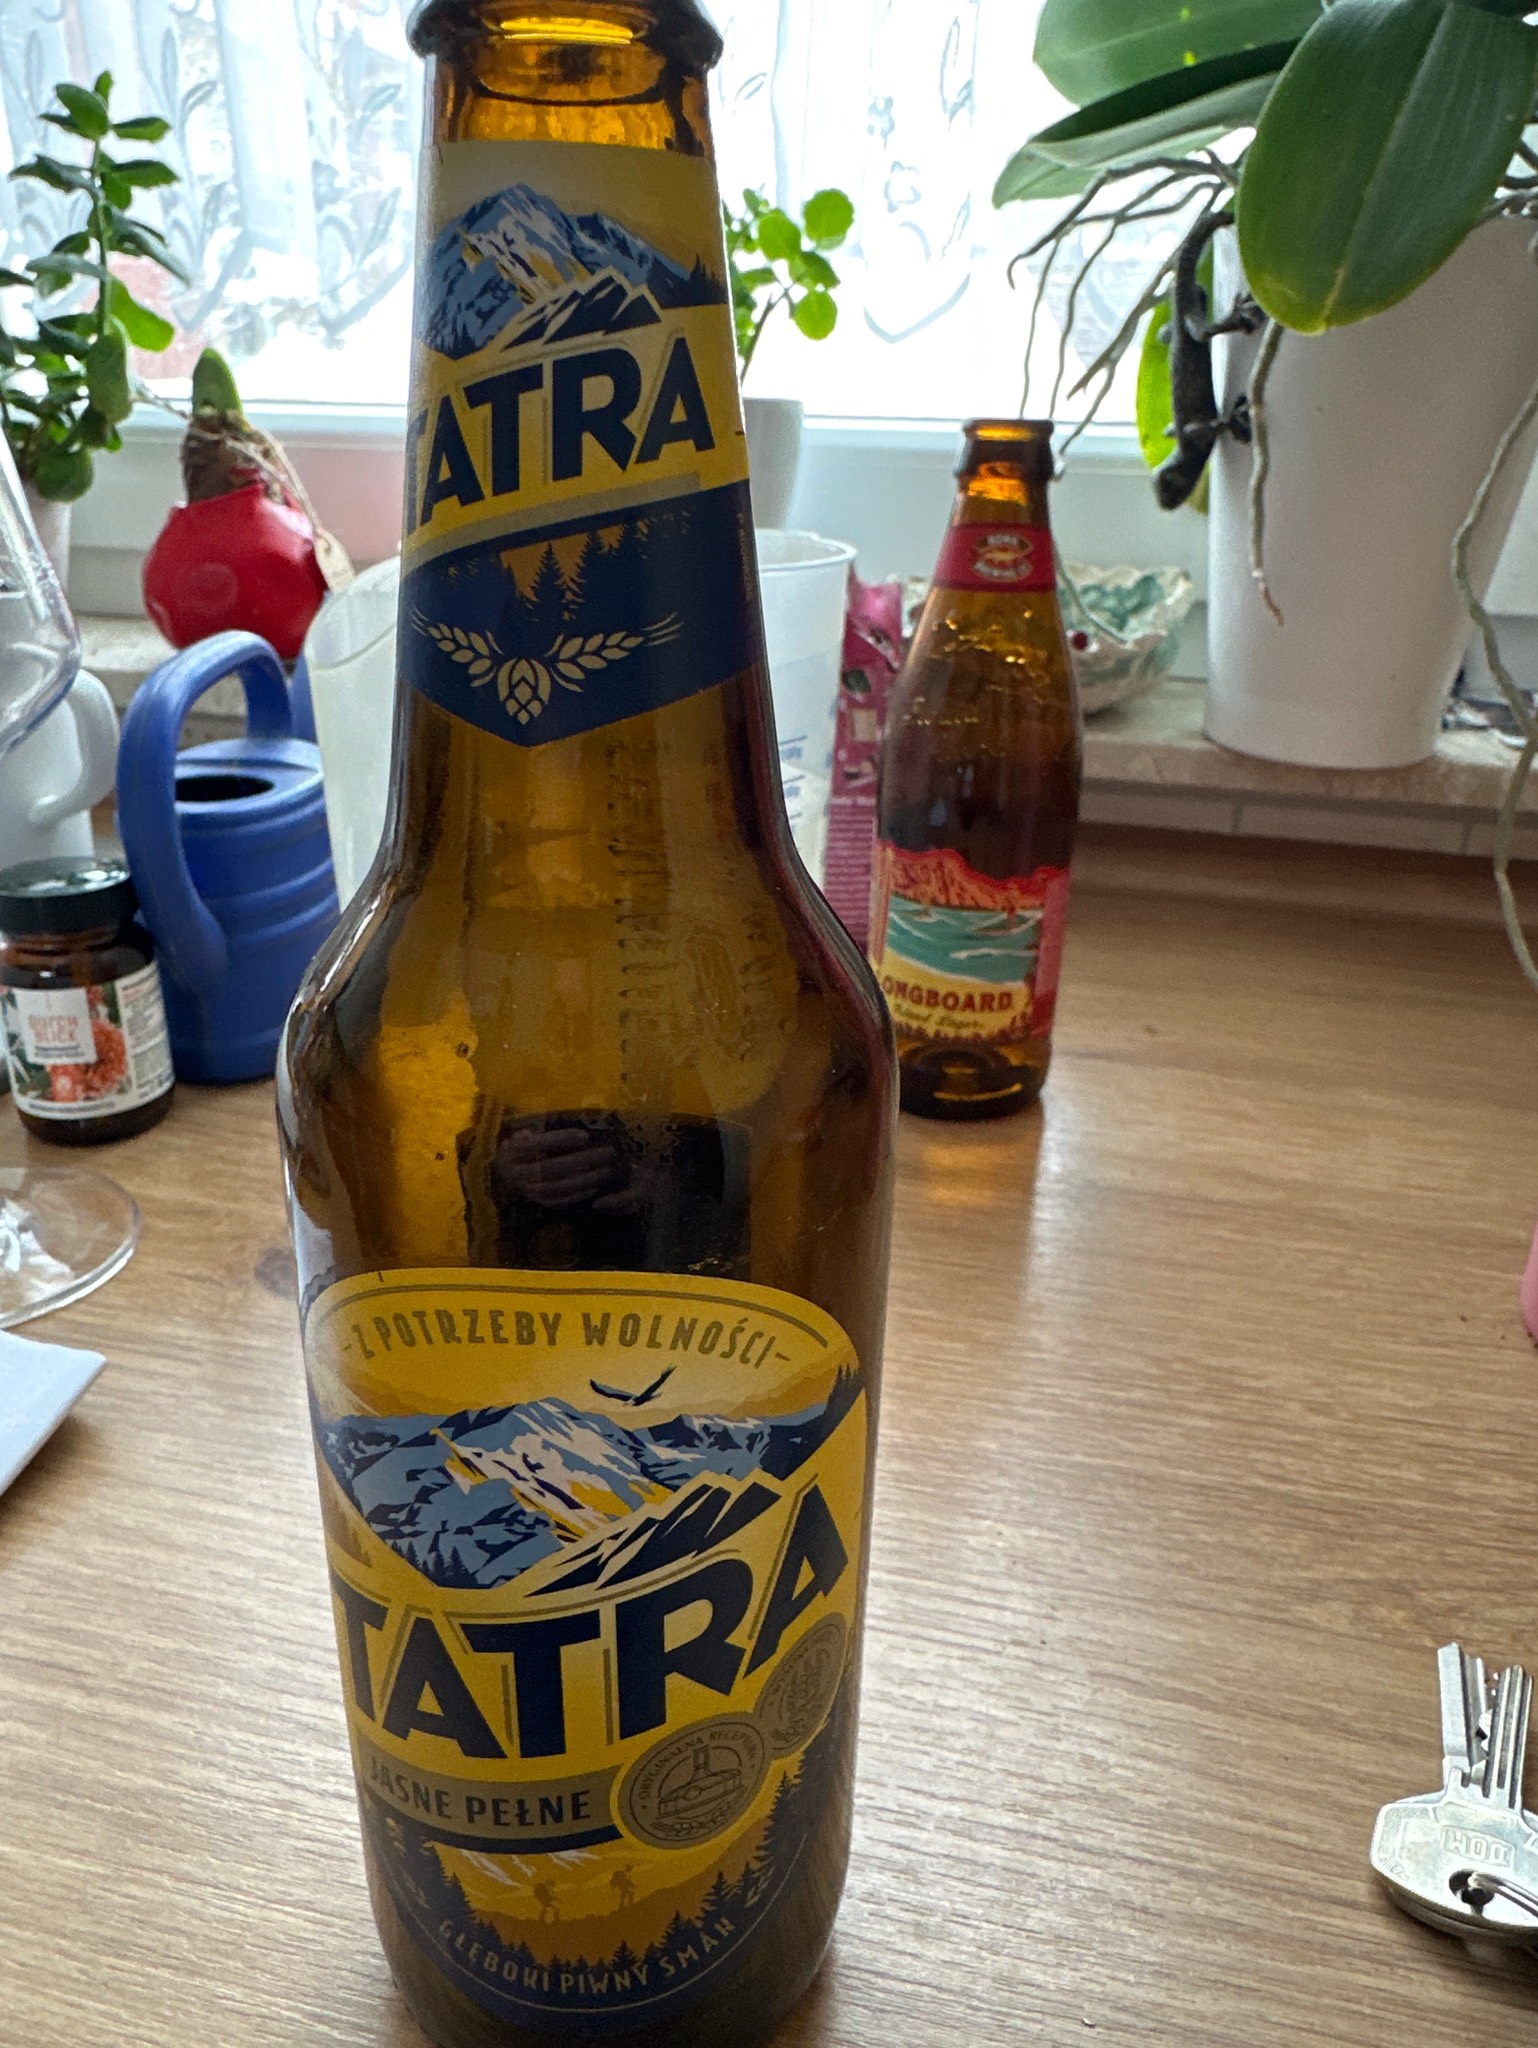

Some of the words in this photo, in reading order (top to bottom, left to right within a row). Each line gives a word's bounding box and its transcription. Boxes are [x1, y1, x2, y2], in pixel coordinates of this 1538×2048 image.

[879, 975, 1014, 1013] ONGBOARD
[372, 1308, 562, 1351] POTRZEBY
[582, 1312, 778, 1369] WOLNOŚCI
[331, 1483, 849, 1760] TATRA
[367, 1754, 452, 1820] JASNE
[465, 1788, 592, 1828] PEŁNE
[1448, 1832, 1510, 1868] DOM
[560, 1964, 650, 1994] PIWNY
